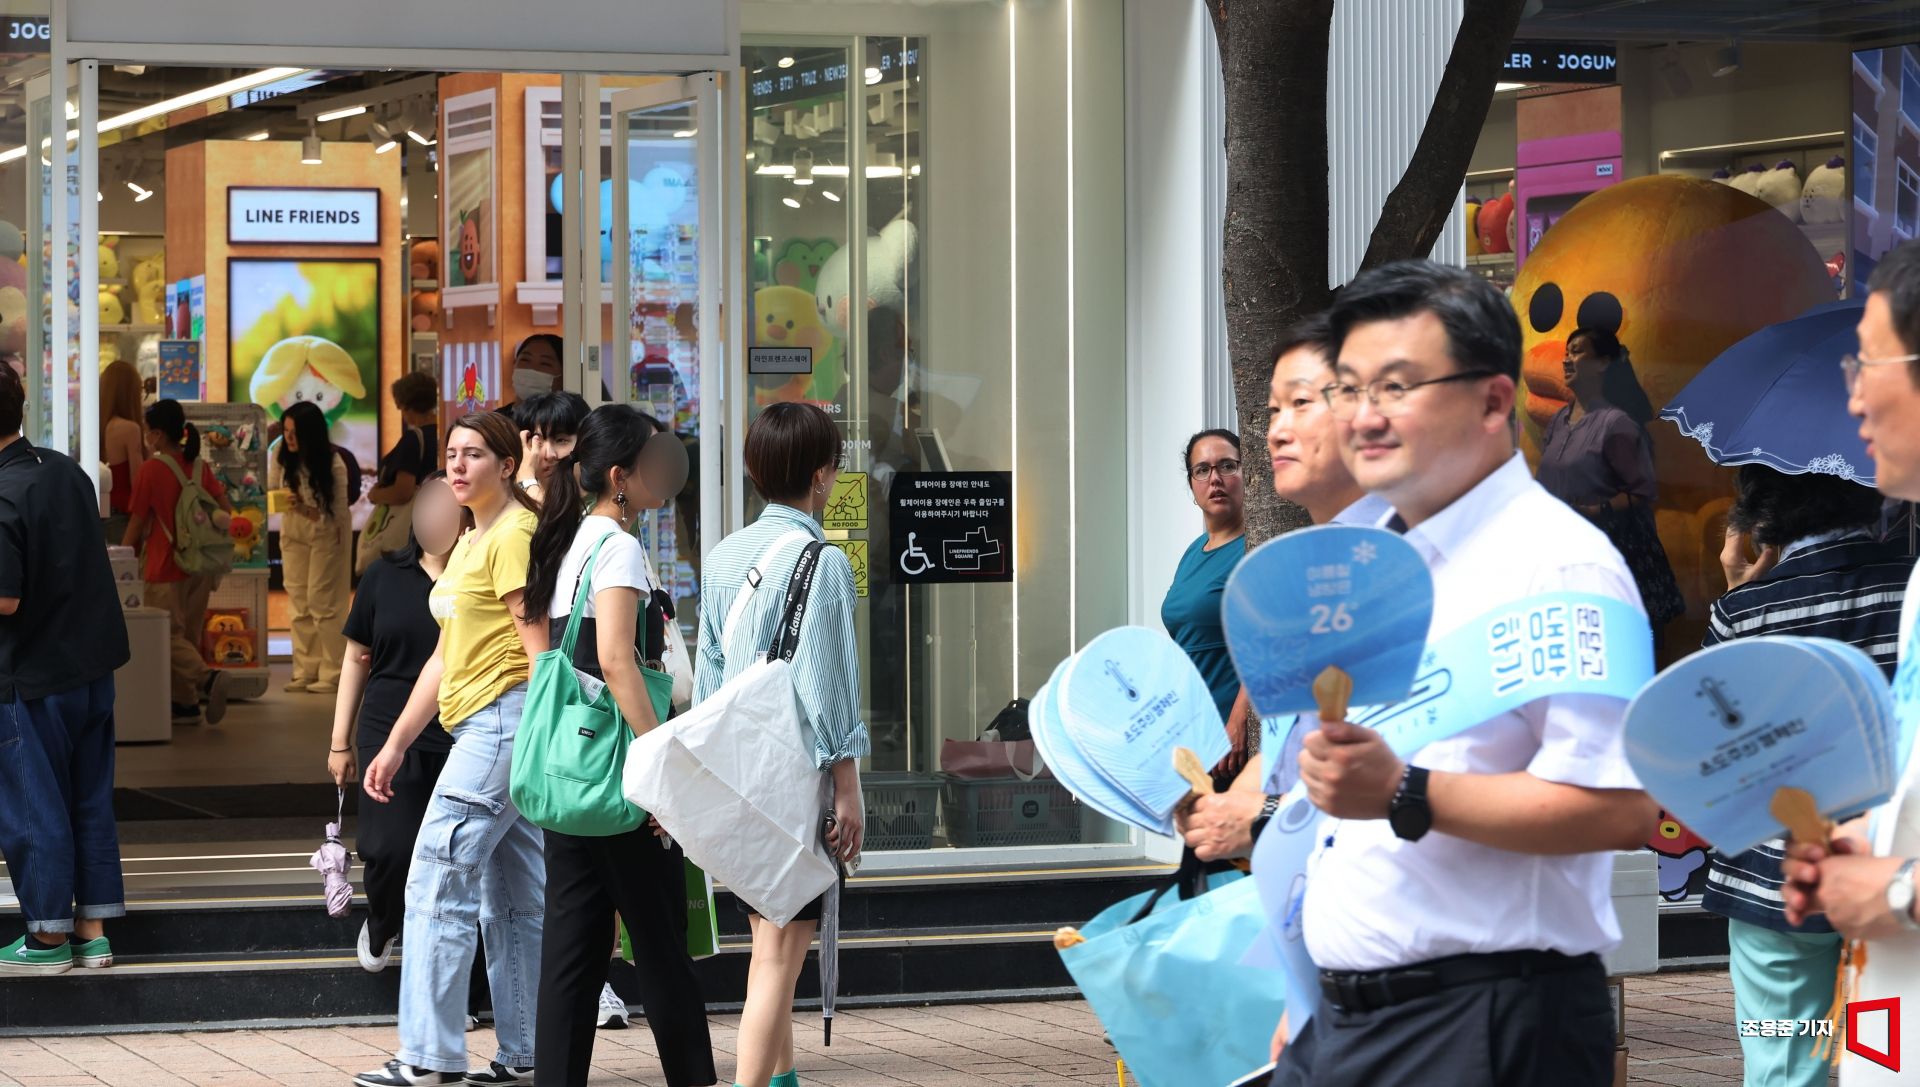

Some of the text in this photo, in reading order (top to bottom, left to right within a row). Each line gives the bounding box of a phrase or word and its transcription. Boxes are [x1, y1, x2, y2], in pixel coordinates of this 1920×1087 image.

[246, 209, 360, 224] LINE FRIENDS
[915, 480, 990, 489] 휠체어이용 장애인 안내도
[900, 498, 933, 507] 휠체어이용
[935, 498, 961, 507] 장애인은
[979, 498, 1005, 507] 출입구를
[914, 510, 989, 518] 이용하여주시기 바랍니다
[788, 603, 803, 637] daiso
[1529, 605, 1567, 677] 냉방
[1576, 606, 1603, 677] 문닫고
[1491, 616, 1524, 692] 하기
